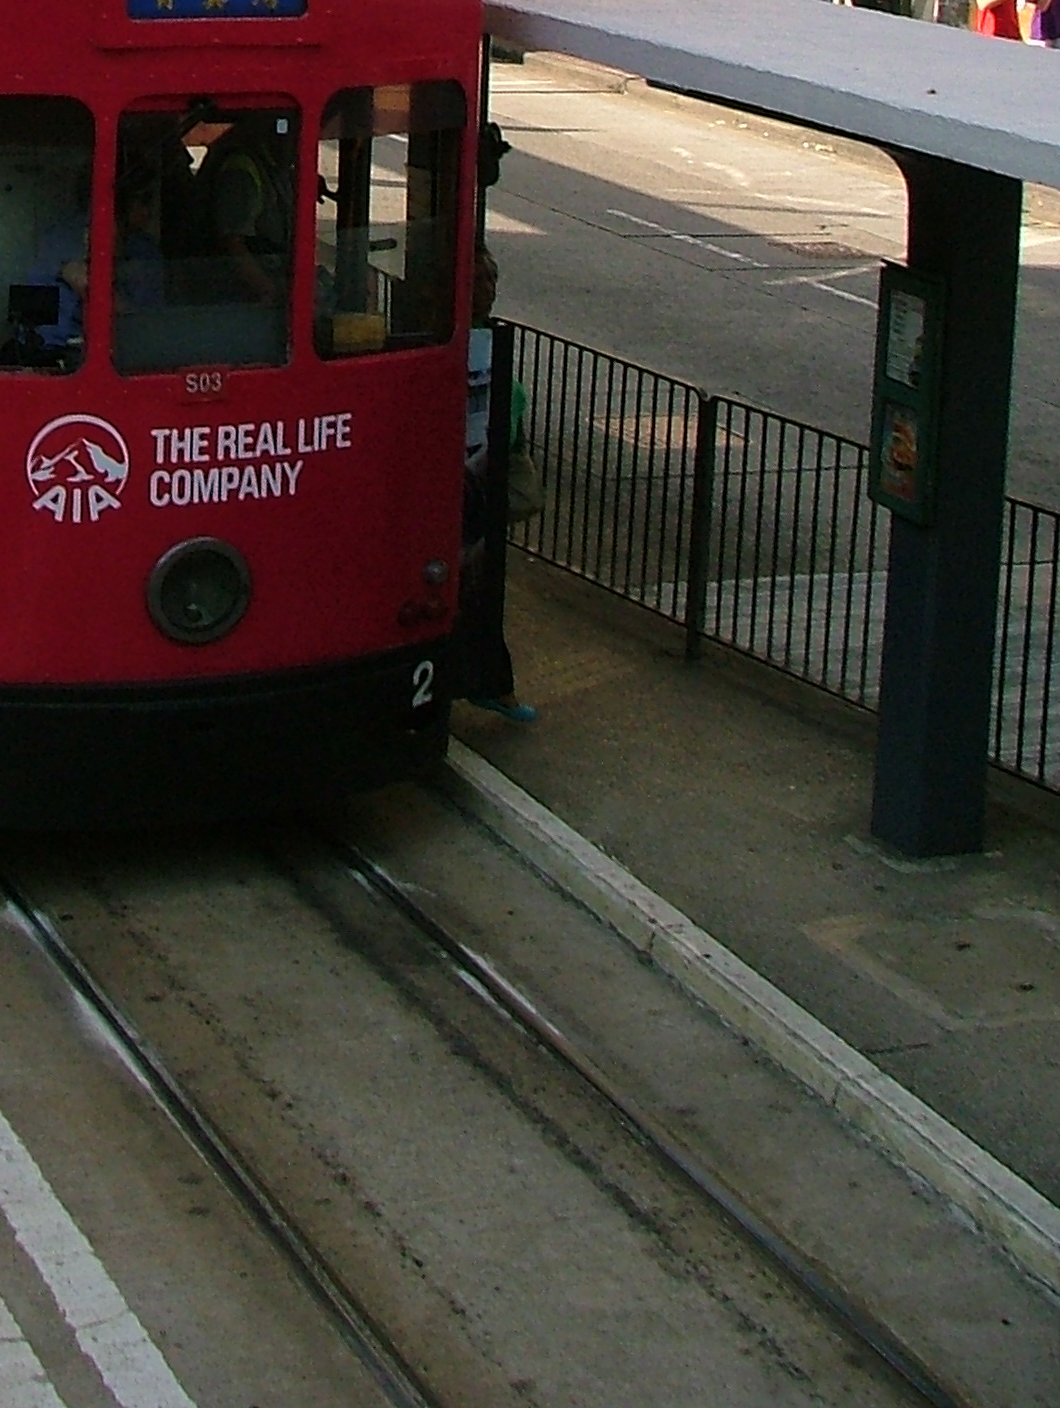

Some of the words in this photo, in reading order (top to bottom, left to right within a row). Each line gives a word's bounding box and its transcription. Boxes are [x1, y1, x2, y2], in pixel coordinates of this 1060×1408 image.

[185, 371, 222, 393] S03
[150, 426, 211, 465] THE
[216, 421, 292, 461] REAL
[298, 412, 353, 454] LIFE
[32, 484, 122, 524] AIA
[149, 460, 304, 508] COMPANY
[412, 659, 434, 709] 2
